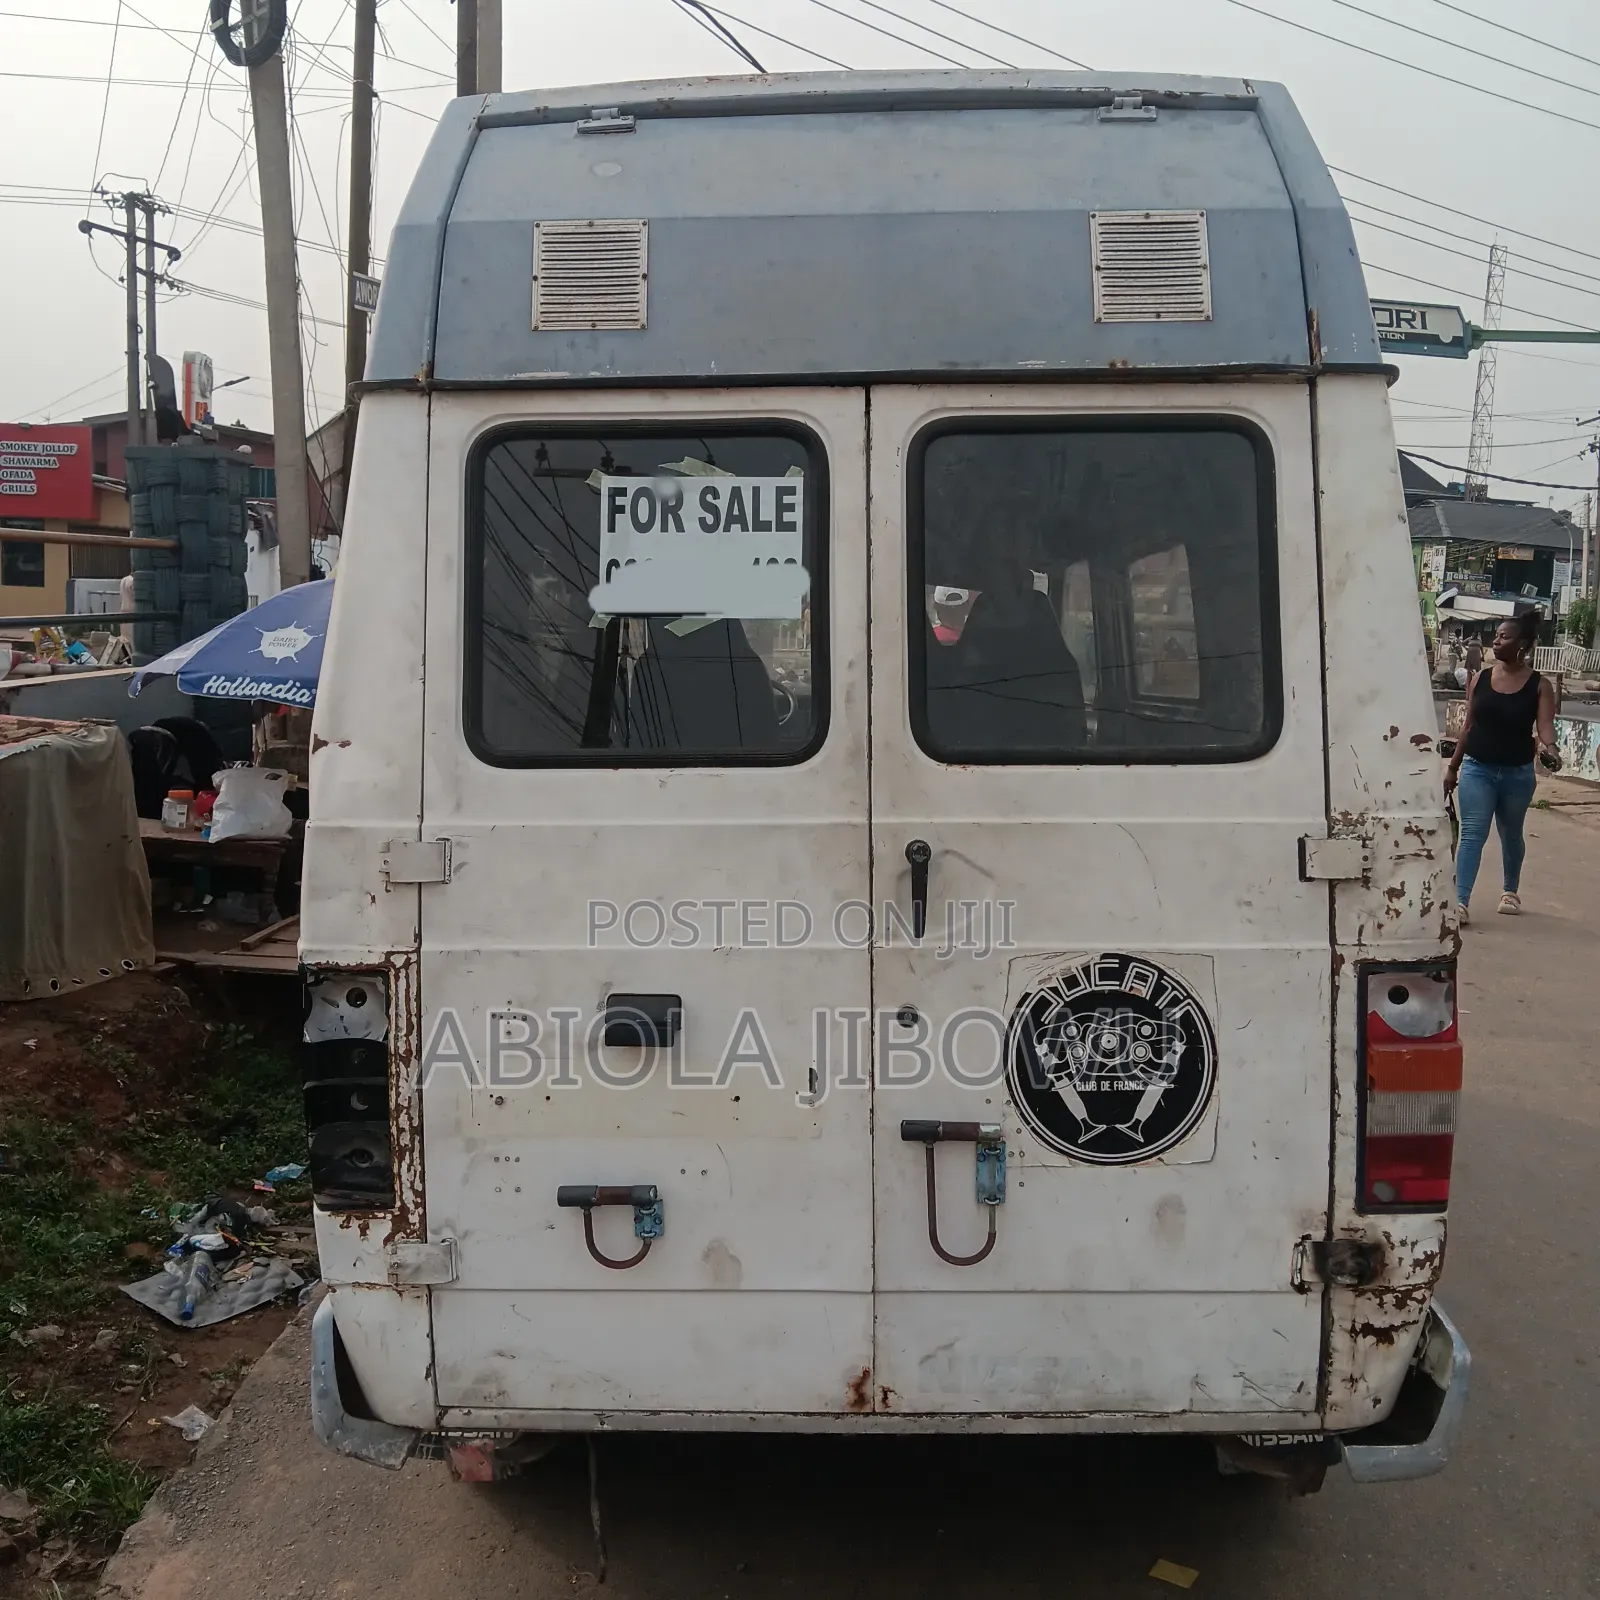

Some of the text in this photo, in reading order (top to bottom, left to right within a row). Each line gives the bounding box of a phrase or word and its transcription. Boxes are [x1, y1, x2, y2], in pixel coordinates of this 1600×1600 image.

[0, 442, 76, 454] SMOKEY JOLLOF
[3, 456, 58, 467] SHAWARMA
[1, 470, 34, 479] OFADA
[1, 484, 36, 493] GRILLS
[606, 485, 798, 534] FOR SALE
[202, 675, 312, 704] Hollandia
[1076, 1080, 1145, 1092] CLUB DE FRANCE
